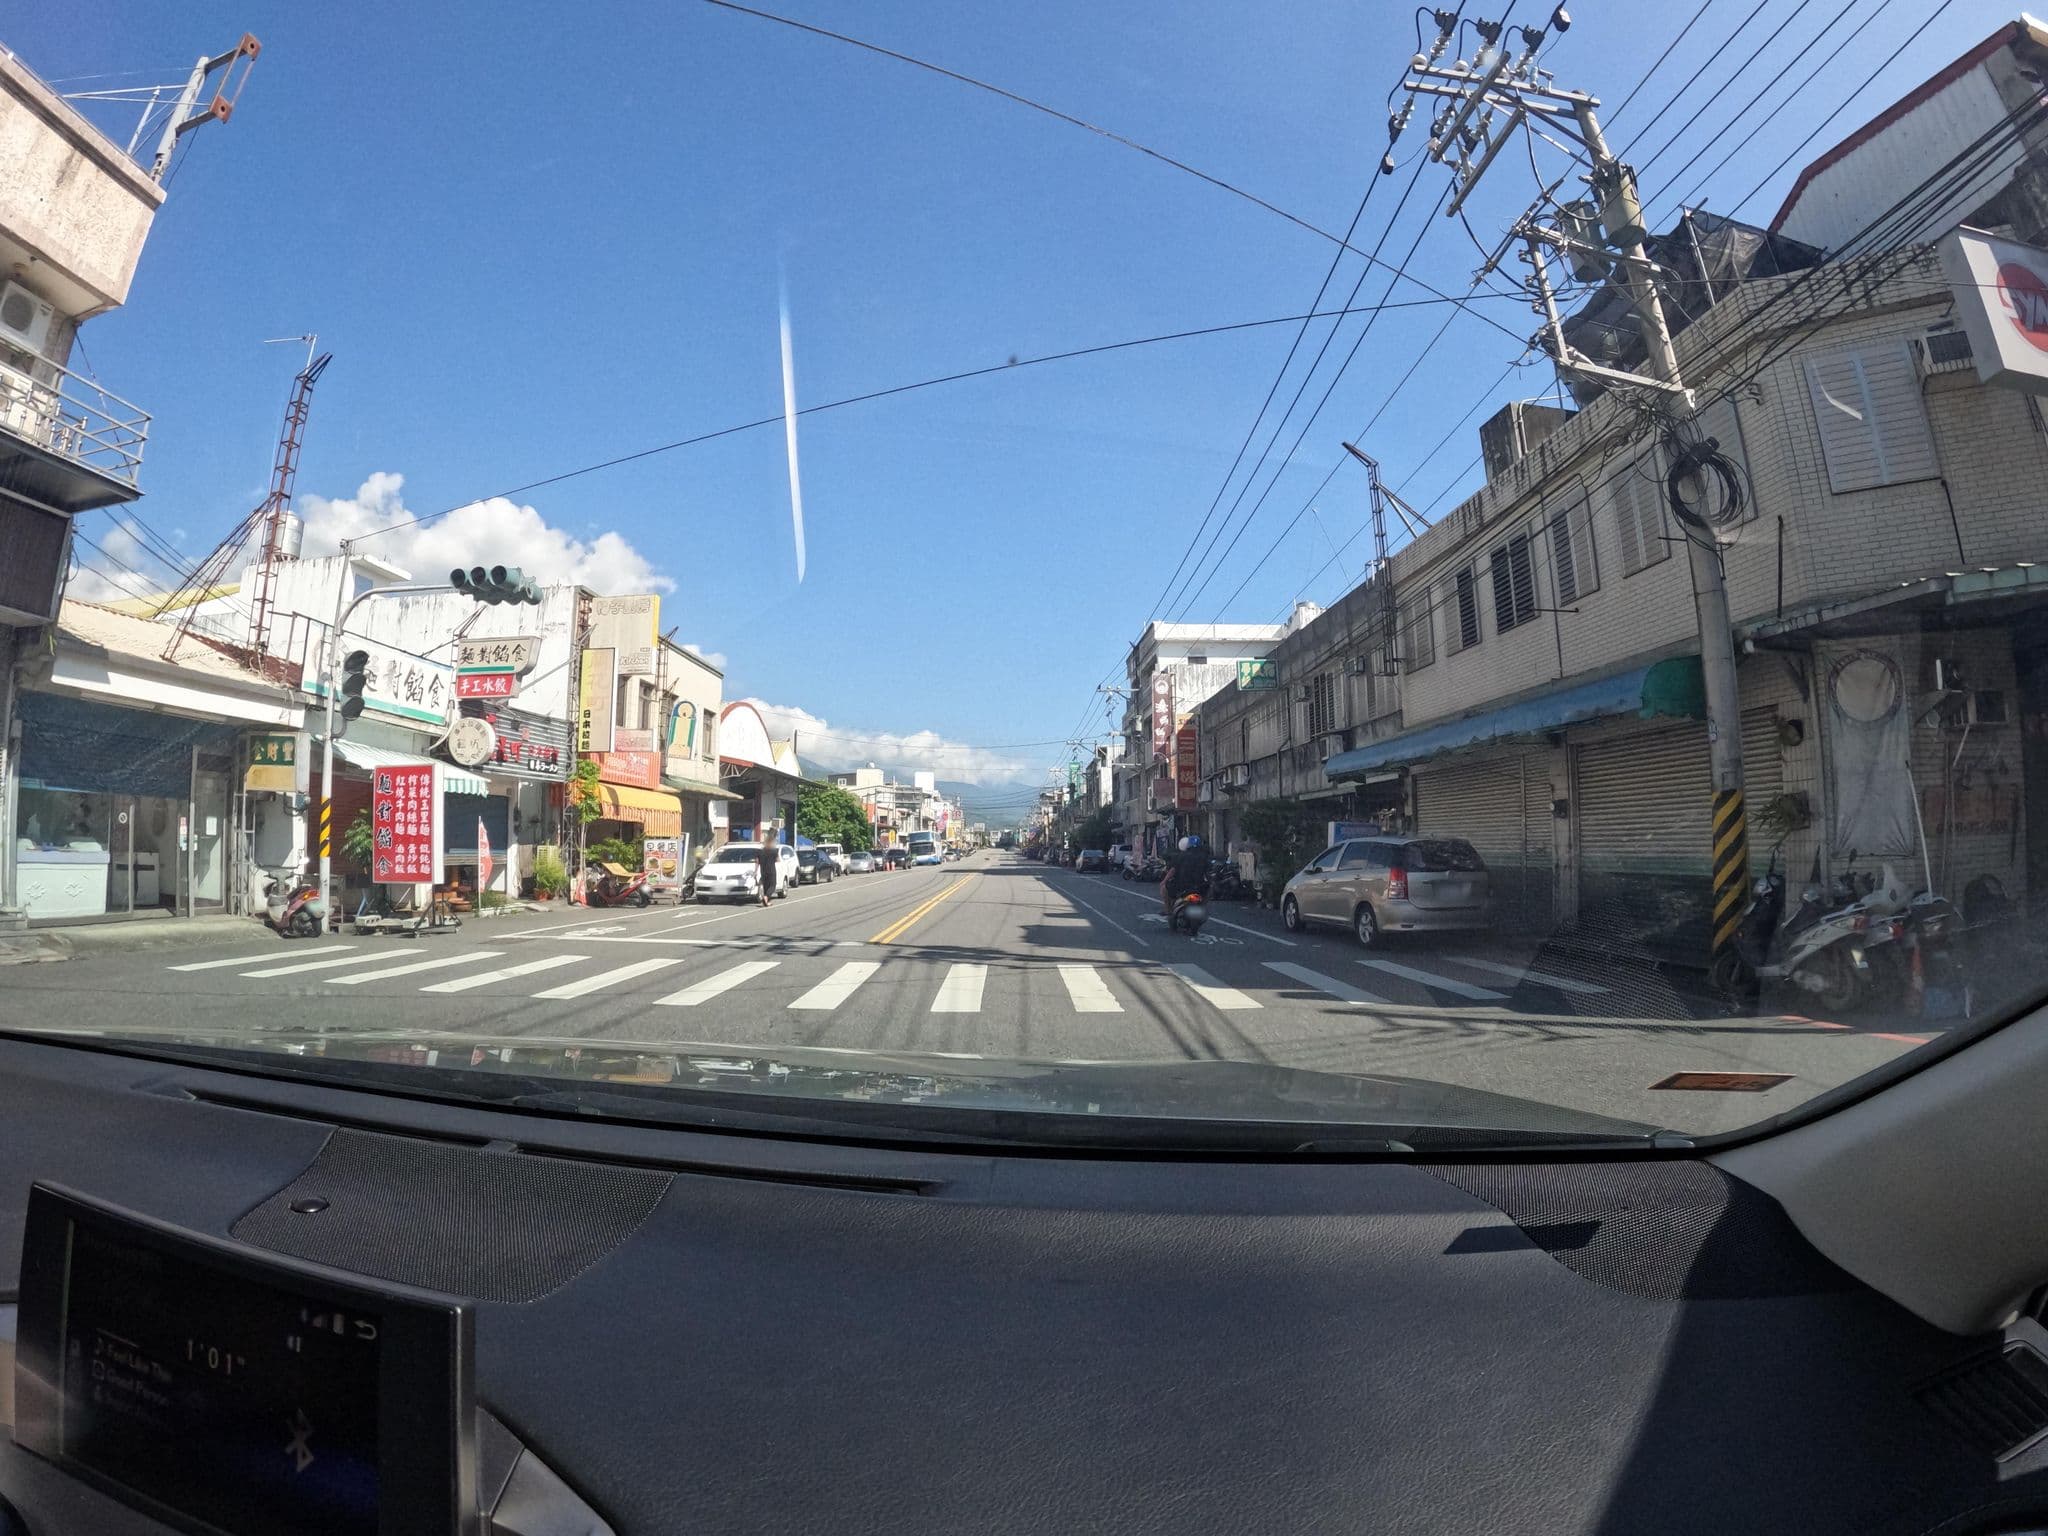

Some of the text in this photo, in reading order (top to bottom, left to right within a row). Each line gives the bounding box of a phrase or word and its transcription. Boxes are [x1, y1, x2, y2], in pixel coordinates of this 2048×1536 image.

[459, 644, 527, 665] 麵對餡食
[459, 677, 508, 694] 手工水餃
[376, 773, 393, 876] 麵對餡食
[395, 774, 406, 836] 紅燒牛肉麵
[419, 773, 431, 837] 傳統玉里麵
[646, 842, 677, 853] 早餐店
